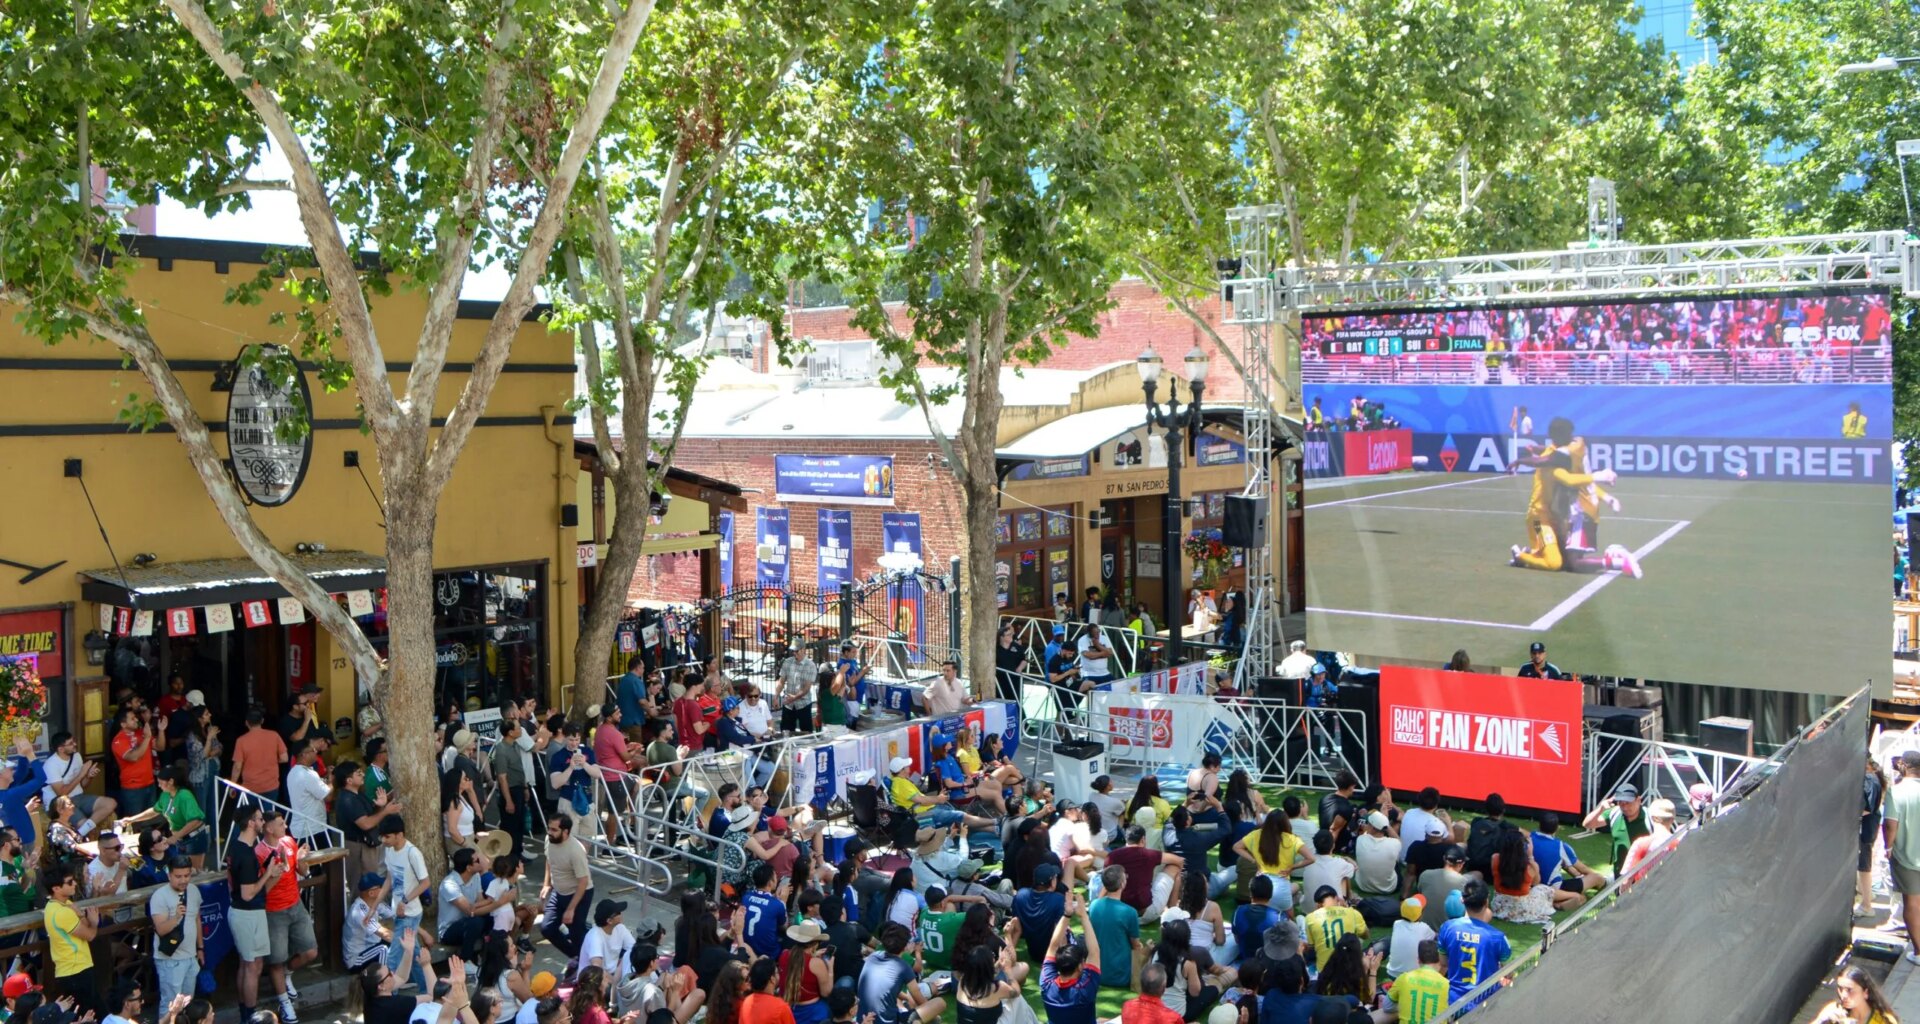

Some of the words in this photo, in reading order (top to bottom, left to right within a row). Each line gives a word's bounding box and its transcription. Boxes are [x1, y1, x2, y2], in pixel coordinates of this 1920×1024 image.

[1406, 328, 1427, 336] GROUP
[1827, 325, 1860, 340] FOX
[1369, 340, 1374, 351] 1
[1394, 340, 1399, 351] 1
[1406, 339, 1421, 350] SUI
[1454, 339, 1483, 350] FINAL
[234, 408, 249, 423] THE
[234, 428, 264, 444] SALOON
[1368, 436, 1397, 471] Lenovo
[1591, 443, 1882, 477] REDICTSTREET
[1106, 484, 1115, 495] 87
[1117, 484, 1123, 494] N
[1126, 482, 1141, 493] SAN
[1142, 480, 1164, 492] PEDRO
[24, 631, 53, 652] TIME
[332, 658, 346, 670] 73
[435, 651, 458, 663] odelo
[478, 722, 495, 732] LINE
[1113, 717, 1137, 727] SAN
[1394, 708, 1424, 734] BAHC
[1429, 711, 1470, 750] FAN
[1474, 716, 1530, 757] ZONE
[837, 766, 860, 777] ULTRA
[748, 905, 761, 936] 7
[921, 928, 944, 953] 10
[1321, 918, 1345, 949] 10
[1461, 945, 1477, 985] 3
[1410, 990, 1440, 1024] 10
